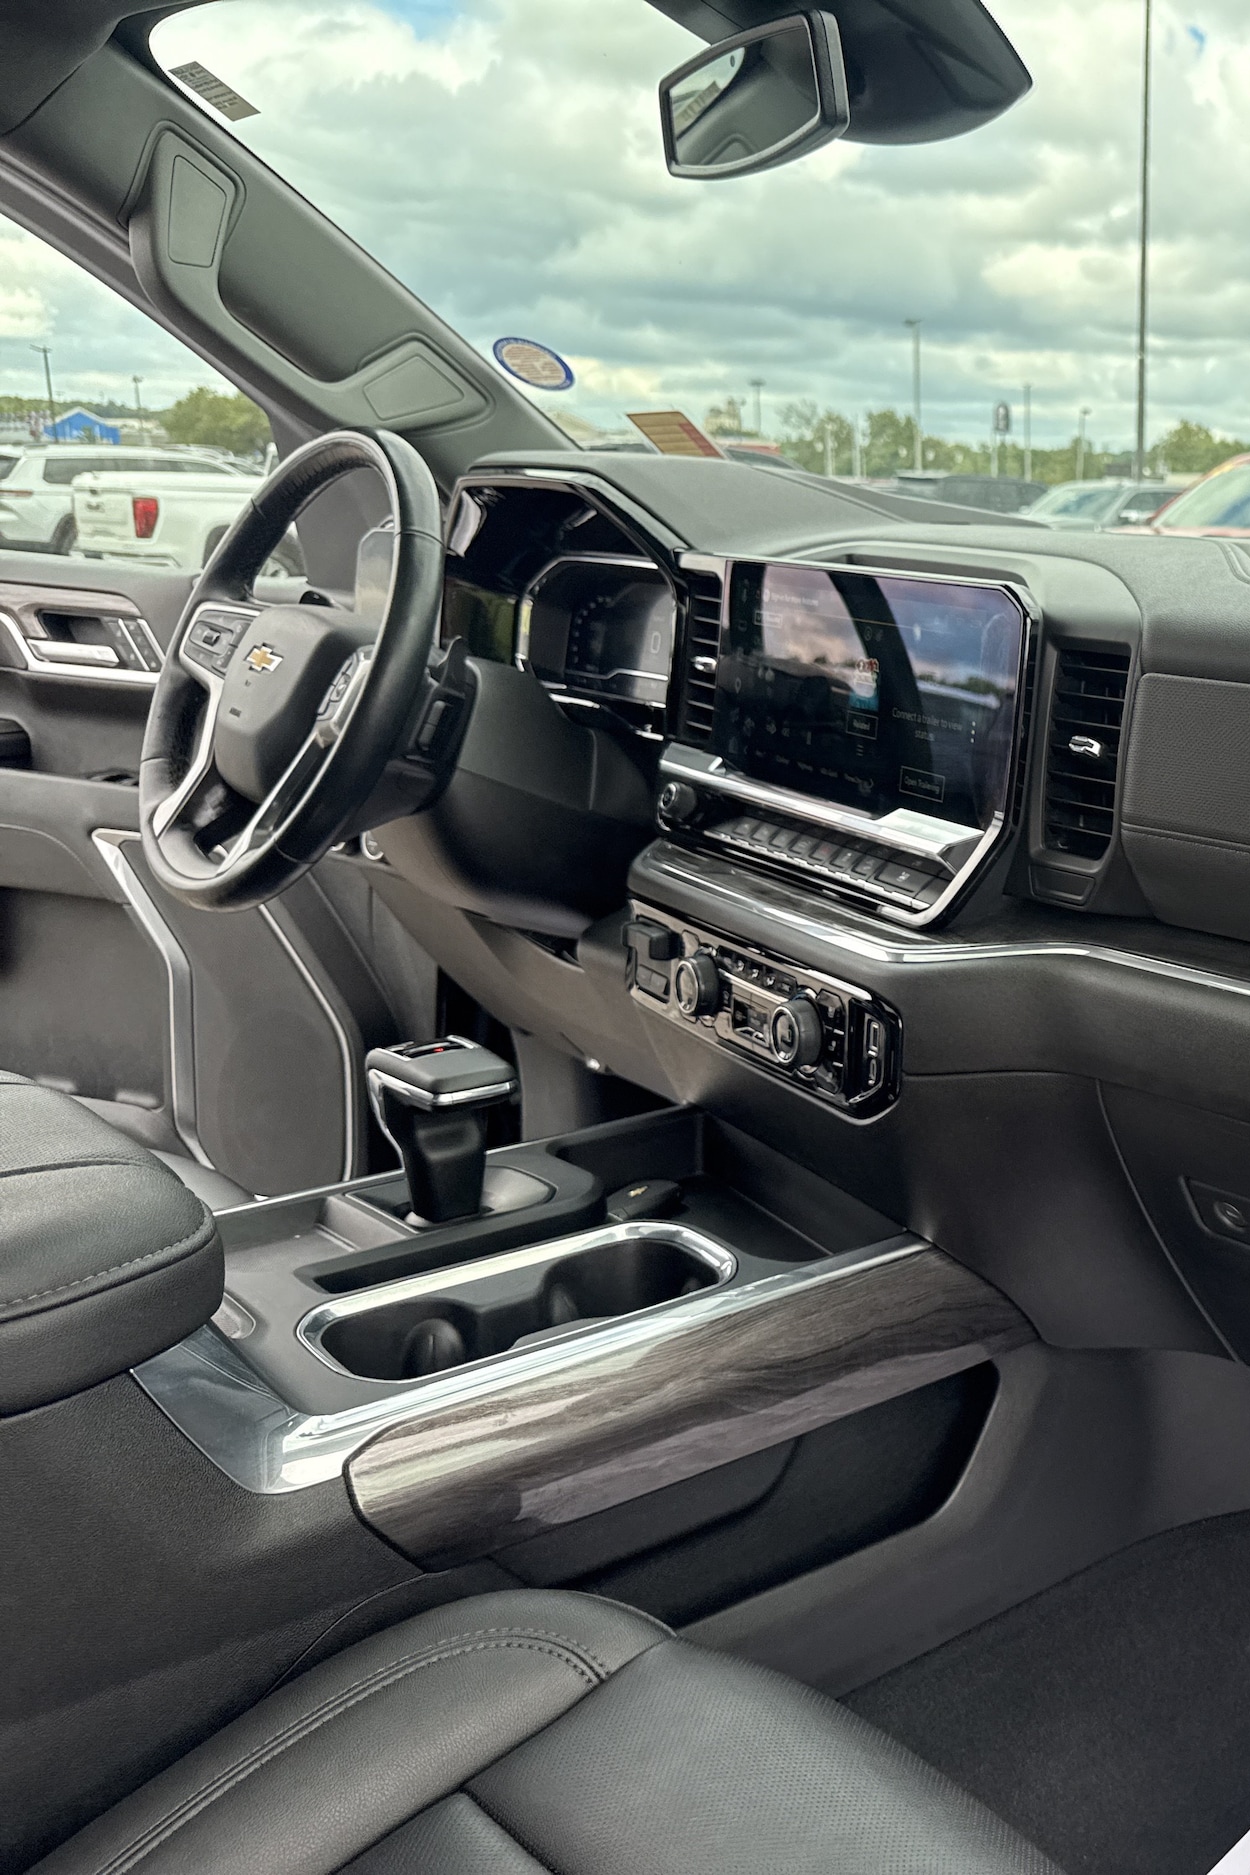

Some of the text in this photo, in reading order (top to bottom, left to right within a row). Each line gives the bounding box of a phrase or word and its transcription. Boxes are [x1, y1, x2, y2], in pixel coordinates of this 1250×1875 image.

[892, 707, 917, 722] Connect
[922, 714, 940, 727] trailer
[940, 718, 948, 729] to
[915, 730, 935, 742] stats
